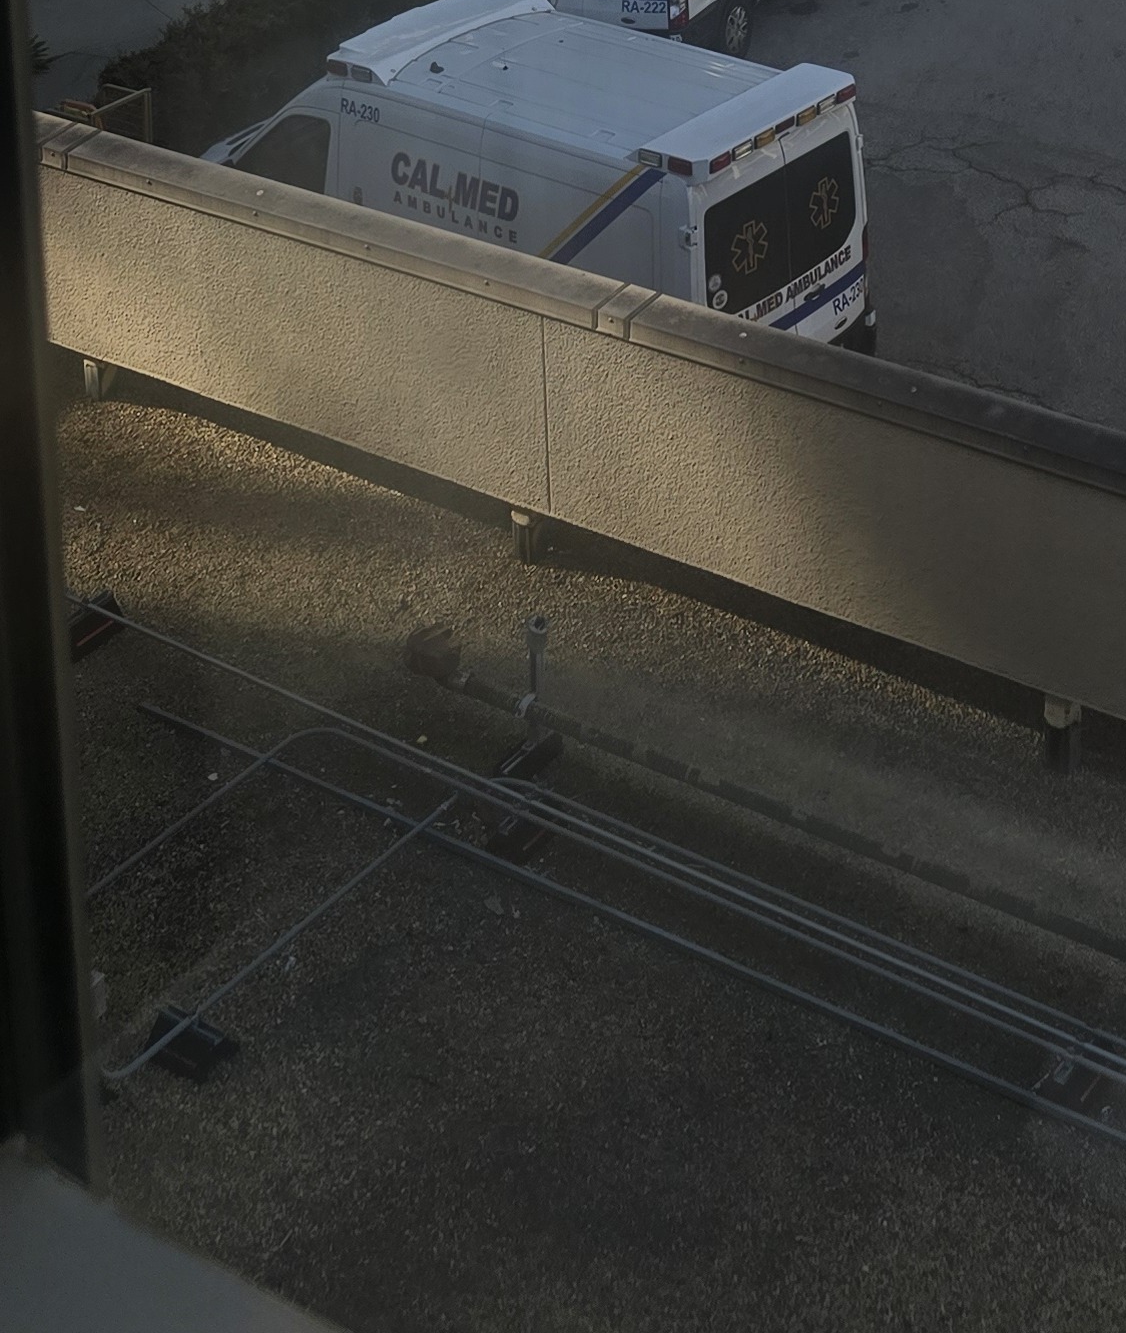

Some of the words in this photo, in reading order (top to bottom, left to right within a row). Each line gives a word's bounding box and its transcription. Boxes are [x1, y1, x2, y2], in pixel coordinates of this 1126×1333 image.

[621, 0, 666, 14] RA-222
[340, 98, 380, 123] RA-230
[393, 191, 518, 244] AMBULANCE
[785, 245, 852, 303] AMBULANCE
